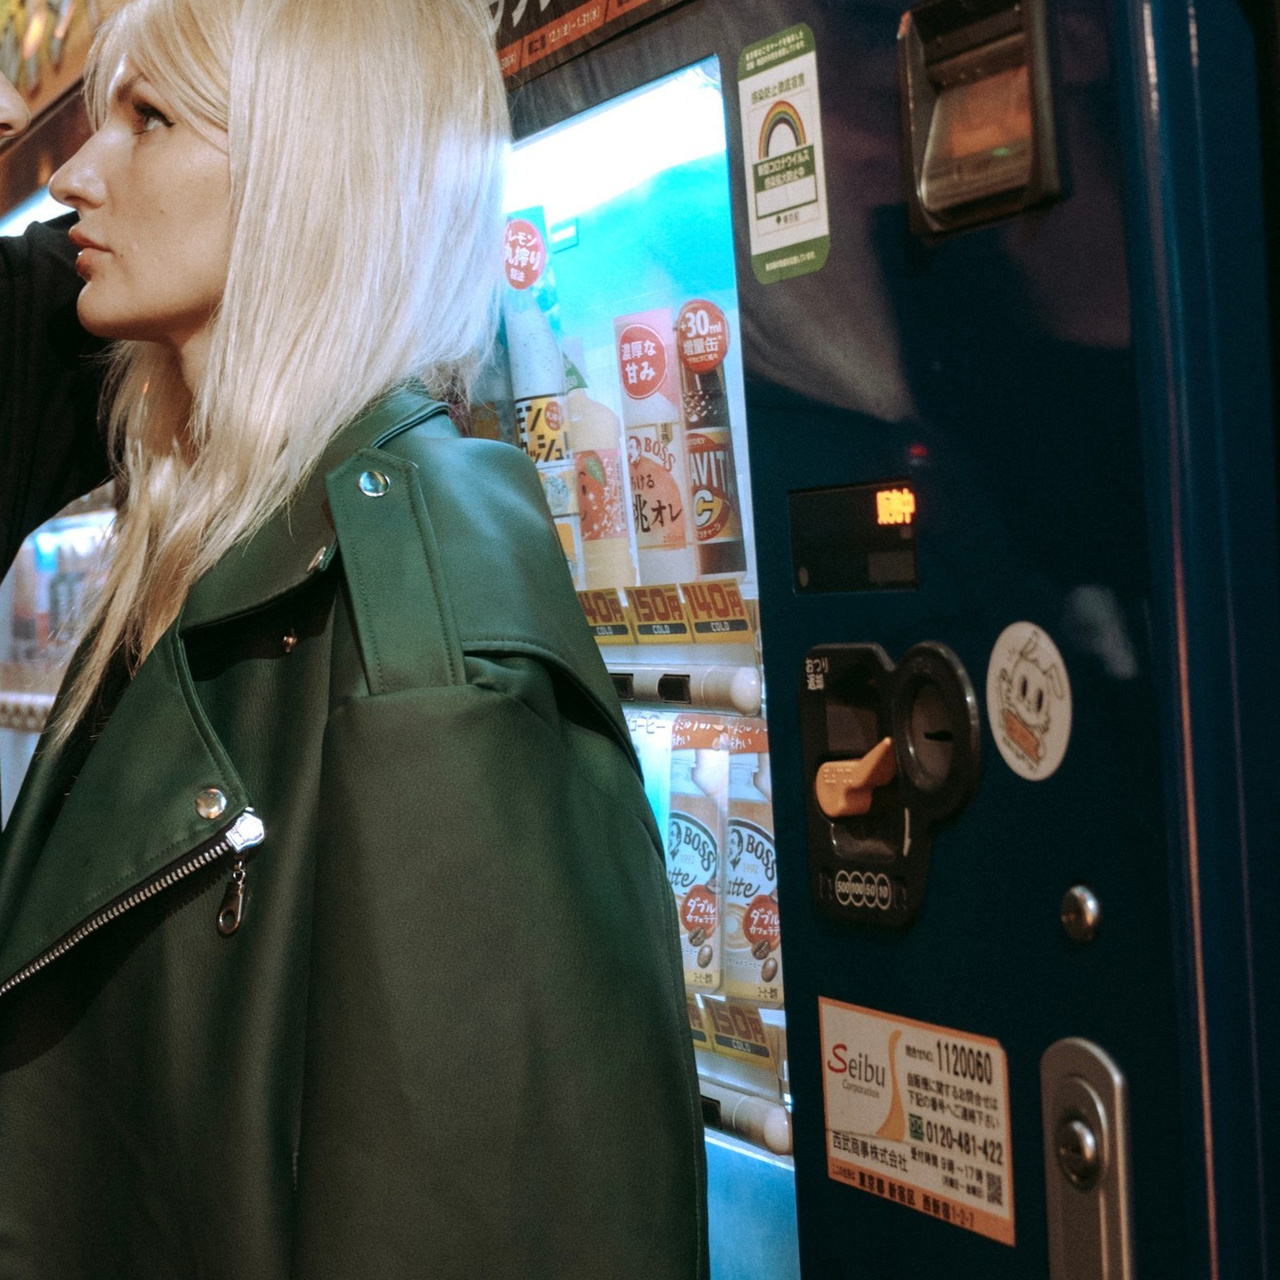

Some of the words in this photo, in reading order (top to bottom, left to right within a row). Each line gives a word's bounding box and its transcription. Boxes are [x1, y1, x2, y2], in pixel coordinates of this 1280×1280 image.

[621, 339, 656, 361] 濃厚な
[625, 361, 655, 384] 甘み
[644, 437, 675, 472] BOSS
[578, 591, 625, 624] 40円
[627, 588, 684, 622] 150円
[682, 583, 744, 619] 140円
[596, 626, 613, 635] COLD
[652, 624, 670, 634] COLD
[710, 621, 730, 632] COLD
[683, 826, 716, 872] BOSS
[746, 833, 777, 882] BOSS
[827, 1043, 886, 1088] Seibu
[936, 1039, 993, 1086] 1120060
[842, 1078, 880, 1100] Corporation
[832, 1130, 908, 1173] 西武商事株式会社
[926, 1120, 1004, 1167] 0120-481-422
